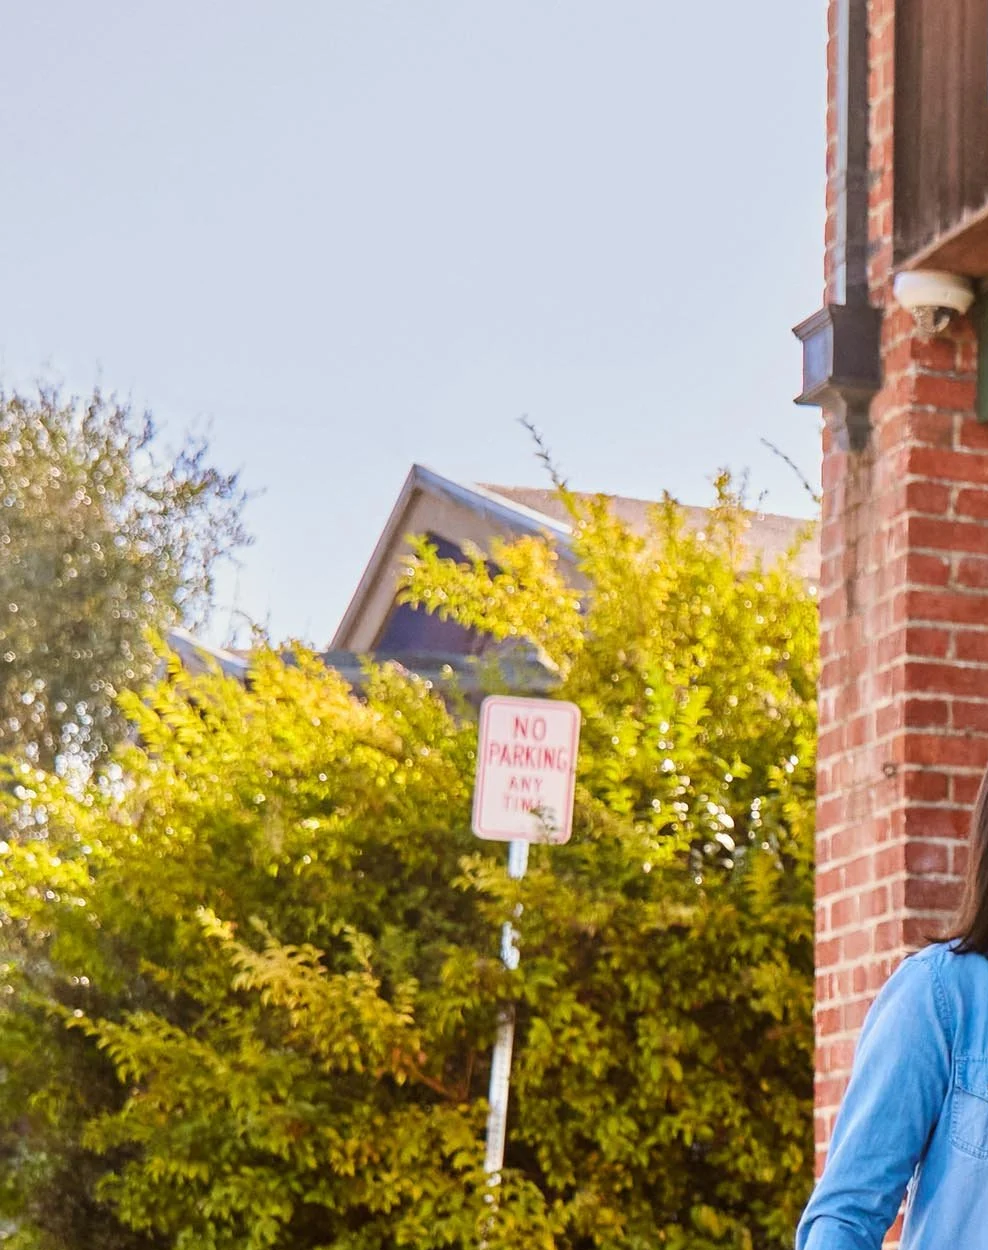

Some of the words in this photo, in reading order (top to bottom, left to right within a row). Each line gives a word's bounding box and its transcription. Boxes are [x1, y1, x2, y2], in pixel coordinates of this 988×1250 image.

[512, 715, 548, 741] NO
[487, 743, 569, 773] PARKING
[508, 775, 543, 793] ANY
